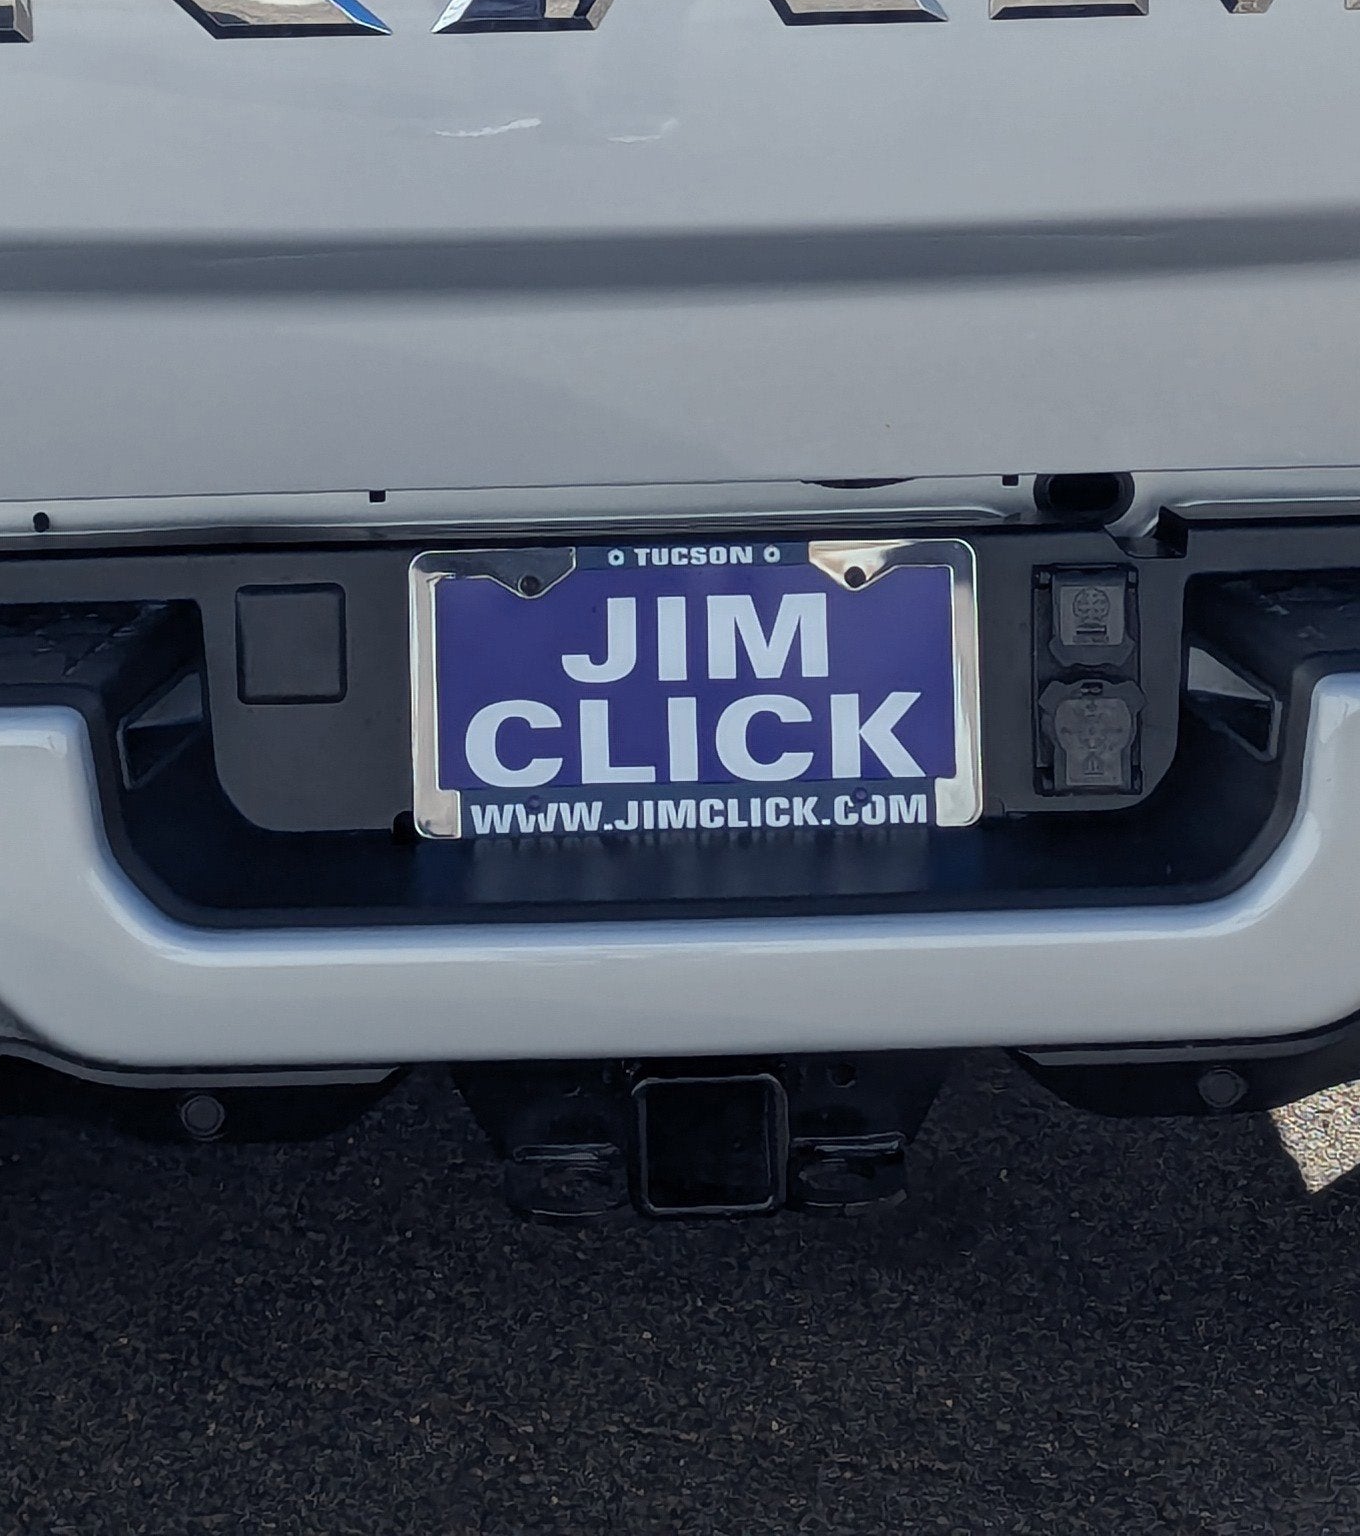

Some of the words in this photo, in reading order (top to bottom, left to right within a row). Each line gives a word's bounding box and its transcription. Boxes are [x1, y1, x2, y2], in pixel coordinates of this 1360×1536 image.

[633, 545, 754, 567] TUCSON
[560, 591, 830, 684] JIM
[463, 690, 927, 789] CLICK
[469, 793, 928, 836] WWW.JIMCLICK.COM
